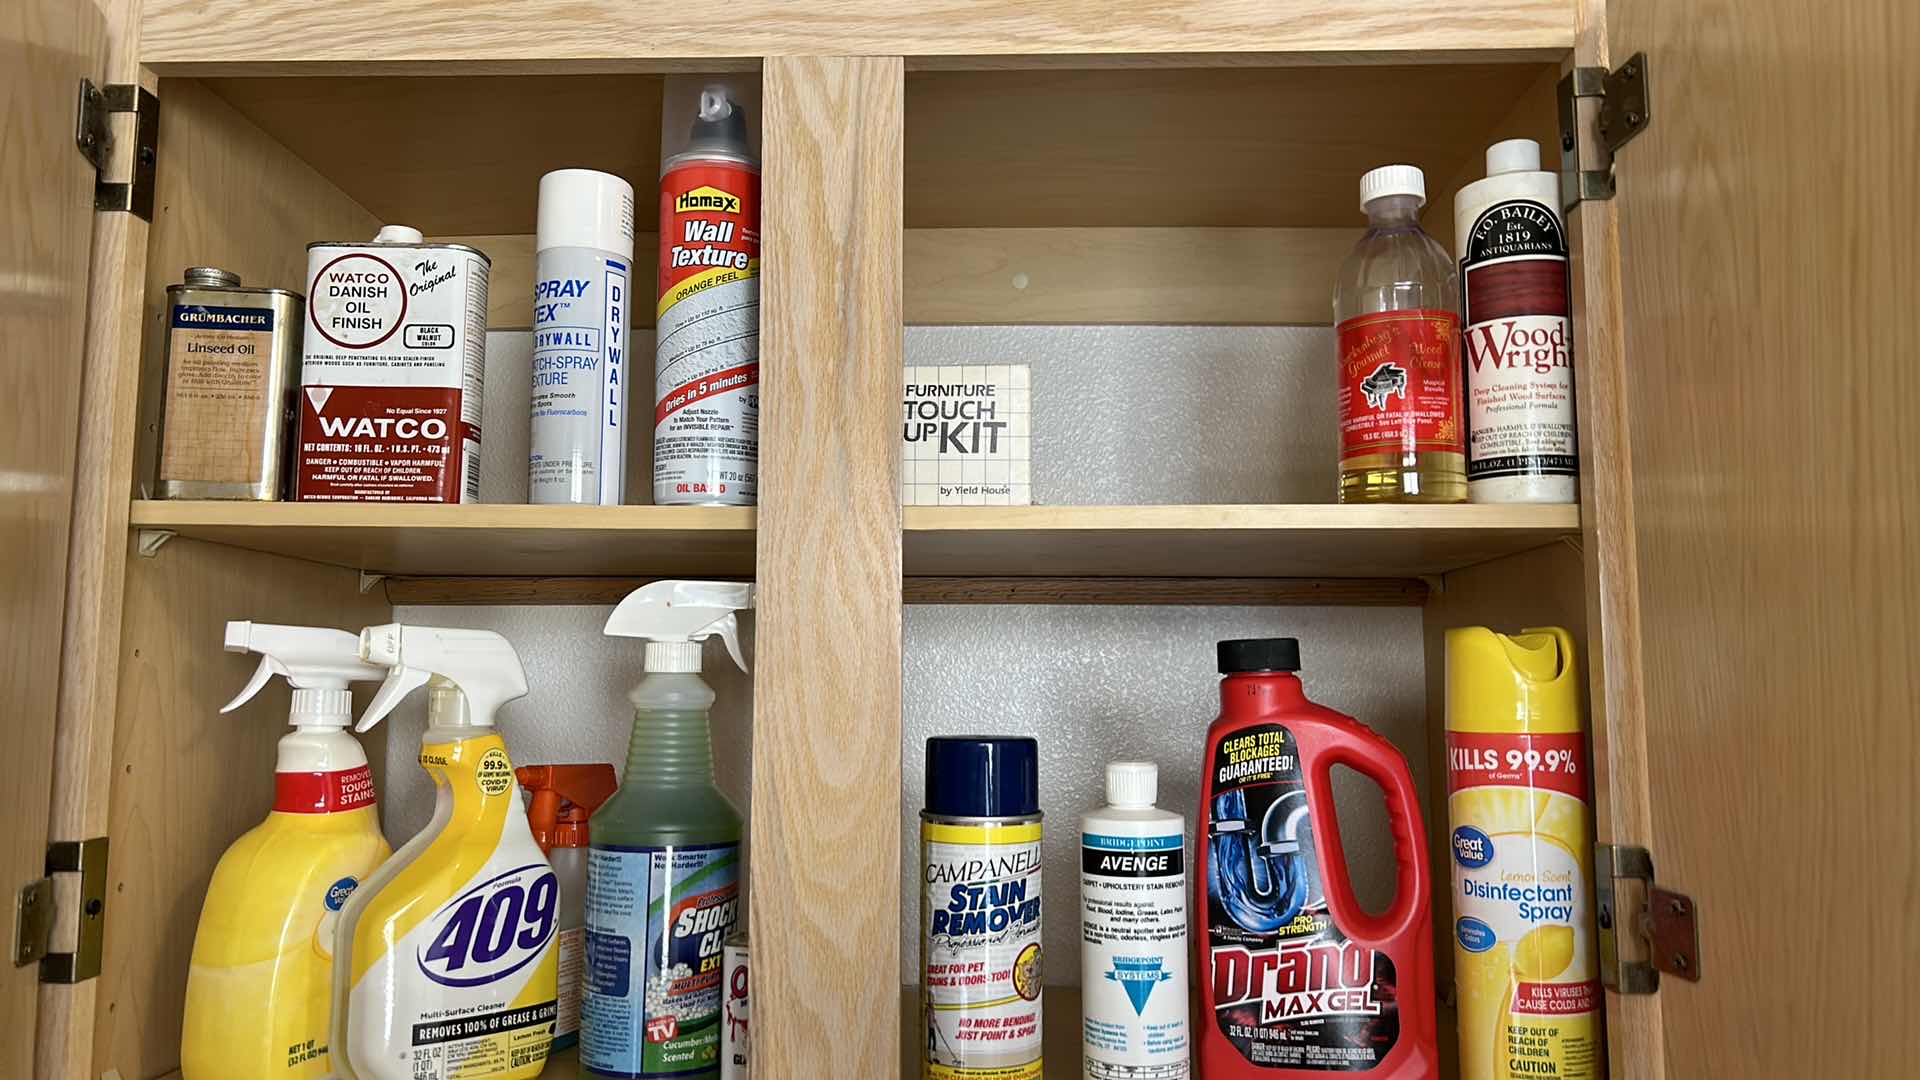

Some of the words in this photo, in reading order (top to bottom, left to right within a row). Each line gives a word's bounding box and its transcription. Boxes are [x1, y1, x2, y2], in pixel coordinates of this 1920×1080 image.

[680, 191, 736, 211] Homax
[1500, 206, 1554, 233] BAILEY
[1506, 222, 1525, 231] Est.
[684, 220, 735, 242] Wall
[1499, 231, 1531, 244] 1819
[1480, 242, 1553, 257] ANTIQUARIANS
[671, 245, 748, 269] Texture
[415, 259, 438, 277] The
[329, 273, 389, 284] WATCO
[409, 265, 457, 297] Original
[675, 277, 713, 300] ORANGE
[715, 271, 739, 284] PEEL
[329, 285, 388, 298] DANISH
[345, 301, 370, 313] OIL
[180, 311, 266, 325] GRUMBACHER
[332, 317, 382, 329] FINISH
[187, 342, 235, 354] Linseed
[238, 344, 255, 354] Oil
[608, 285, 621, 426] DRYWALL
[665, 395, 686, 413] Dries
[686, 388, 697, 402] in
[699, 381, 708, 395] 5
[709, 372, 748, 393] minutes
[905, 384, 995, 397] FURNITURE
[1491, 383, 1527, 393] Cleaning
[1476, 394, 1507, 405] Finished
[1509, 392, 1533, 400] Wood
[1535, 391, 1566, 400] Surfaces
[396, 408, 414, 416] Equal
[904, 400, 996, 420] TOUCH
[1486, 402, 1527, 413] Professional
[1529, 401, 1558, 409] Formula
[319, 416, 447, 439] WATCO
[904, 422, 937, 442] UP
[939, 421, 1007, 454] KIT
[304, 443, 315, 452] NET
[316, 443, 352, 452] CONTENTS:
[363, 444, 373, 453] FL.
[427, 445, 440, 453] 473
[676, 483, 690, 493] OIL
[940, 486, 952, 497] by
[954, 486, 978, 495] Yield
[981, 486, 1010, 495] House
[1223, 735, 1256, 754] CLEARS
[1257, 731, 1285, 744] TOTAL
[1230, 744, 1280, 764] BLOCKAGES
[1451, 748, 1498, 770] KILLS
[1505, 749, 1576, 774] 99.9%
[1219, 755, 1294, 783] GUARANTEED!
[341, 779, 374, 794] TOUGH
[340, 789, 376, 805] STAINS
[1100, 837, 1165, 847] BRIDGEPOINT
[1454, 833, 1483, 850] Great
[677, 853, 707, 861] Smarter
[1458, 849, 1484, 861] Value
[1100, 856, 1168, 871] AVENGE
[492, 876, 522, 889] Formula
[1500, 869, 1537, 882] Lemon
[1542, 869, 1572, 882] Scent
[1102, 882, 1144, 891] UPHOLSTERY
[1146, 882, 1163, 890] STAIN
[1464, 879, 1572, 901] Disinfectant
[948, 879, 1027, 912] STAIN
[931, 896, 1040, 937] REMOVER
[1519, 902, 1573, 923] Spray
[424, 871, 558, 972] 409
[674, 902, 737, 938] SHOCK
[1294, 916, 1313, 925] PRO
[1279, 920, 1328, 936] STRENGTH
[949, 964, 966, 974] FOR
[967, 962, 985, 973] PET
[1117, 971, 1160, 979] SYSTEMS
[992, 970, 1011, 982] TOO!
[1531, 987, 1553, 998] KILLS
[1554, 987, 1582, 998] VIRUSES
[420, 1007, 475, 1020] Multi-Surface
[477, 1001, 506, 1012] Cleaner
[1265, 992, 1323, 1020] MAX
[1327, 991, 1378, 1011] GEL
[1517, 999, 1548, 1010] CAUSE
[1549, 999, 1576, 1010] COLDS
[419, 1024, 462, 1041] REMOVES
[464, 1018, 487, 1034] 100%
[489, 1017, 500, 1029] OF
[501, 1011, 530, 1027] GREASE
[959, 1018, 972, 1028] NO
[974, 1018, 1001, 1029] MORE
[1229, 1025, 1237, 1036] 32
[648, 1021, 676, 1041] TV
[955, 1031, 979, 1040] JUST
[980, 1030, 1006, 1041] POINT
[1507, 1025, 1528, 1035] KEEP
[1530, 1027, 1546, 1036] OUT
[1548, 1028, 1560, 1037] OF
[1508, 1035, 1535, 1046] REACH
[1538, 1037, 1549, 1047] OF
[413, 1051, 422, 1061] 32
[423, 1049, 432, 1060] FL
[432, 1047, 442, 1058] OZ
[662, 1050, 695, 1063] Scented
[1508, 1046, 1550, 1058] CHILDREN
[1509, 1058, 1557, 1074] CAUTION
